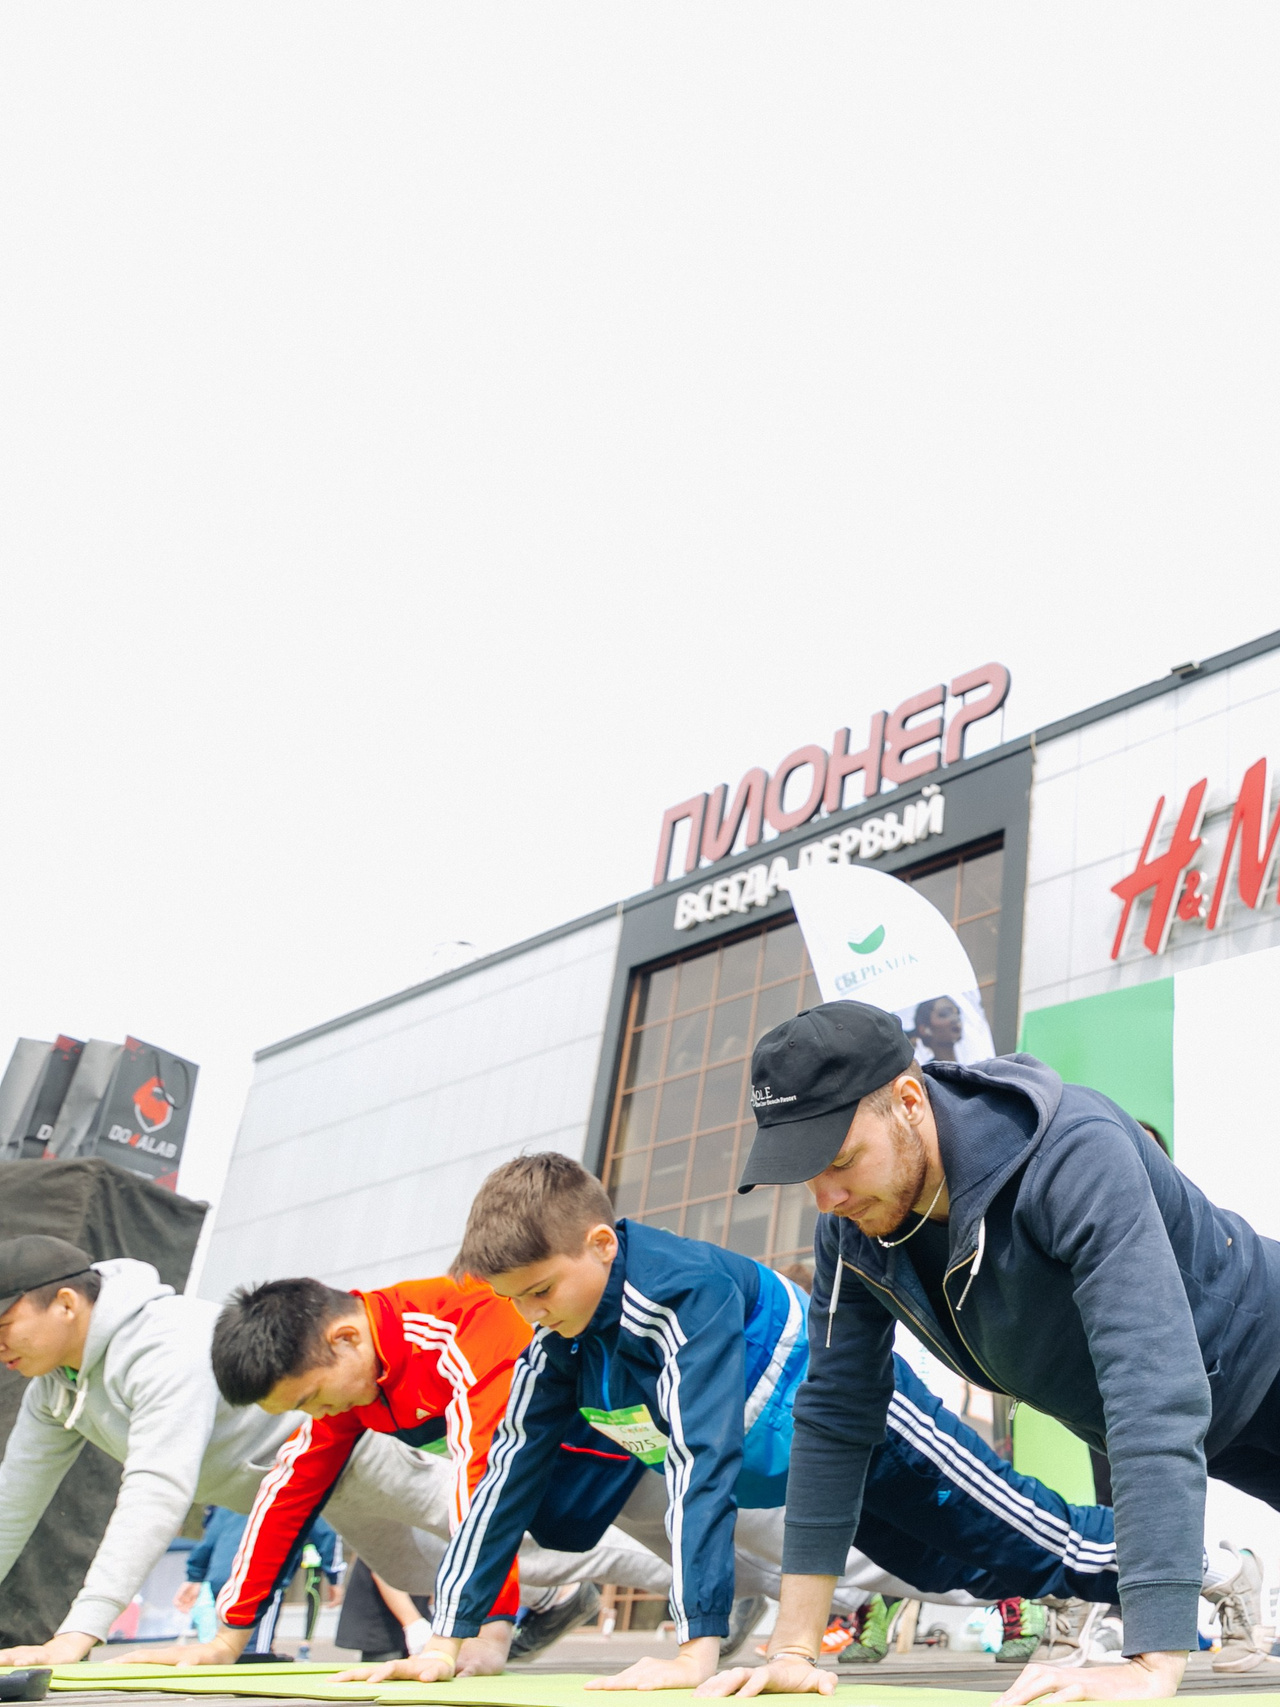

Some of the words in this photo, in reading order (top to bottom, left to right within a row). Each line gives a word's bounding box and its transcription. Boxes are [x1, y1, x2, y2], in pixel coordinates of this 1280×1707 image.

[653, 661, 1011, 887] ПИОНЕР
[673, 855, 790, 931] ВСЕГДА
[797, 783, 946, 868] ПЕРВЫЙ
